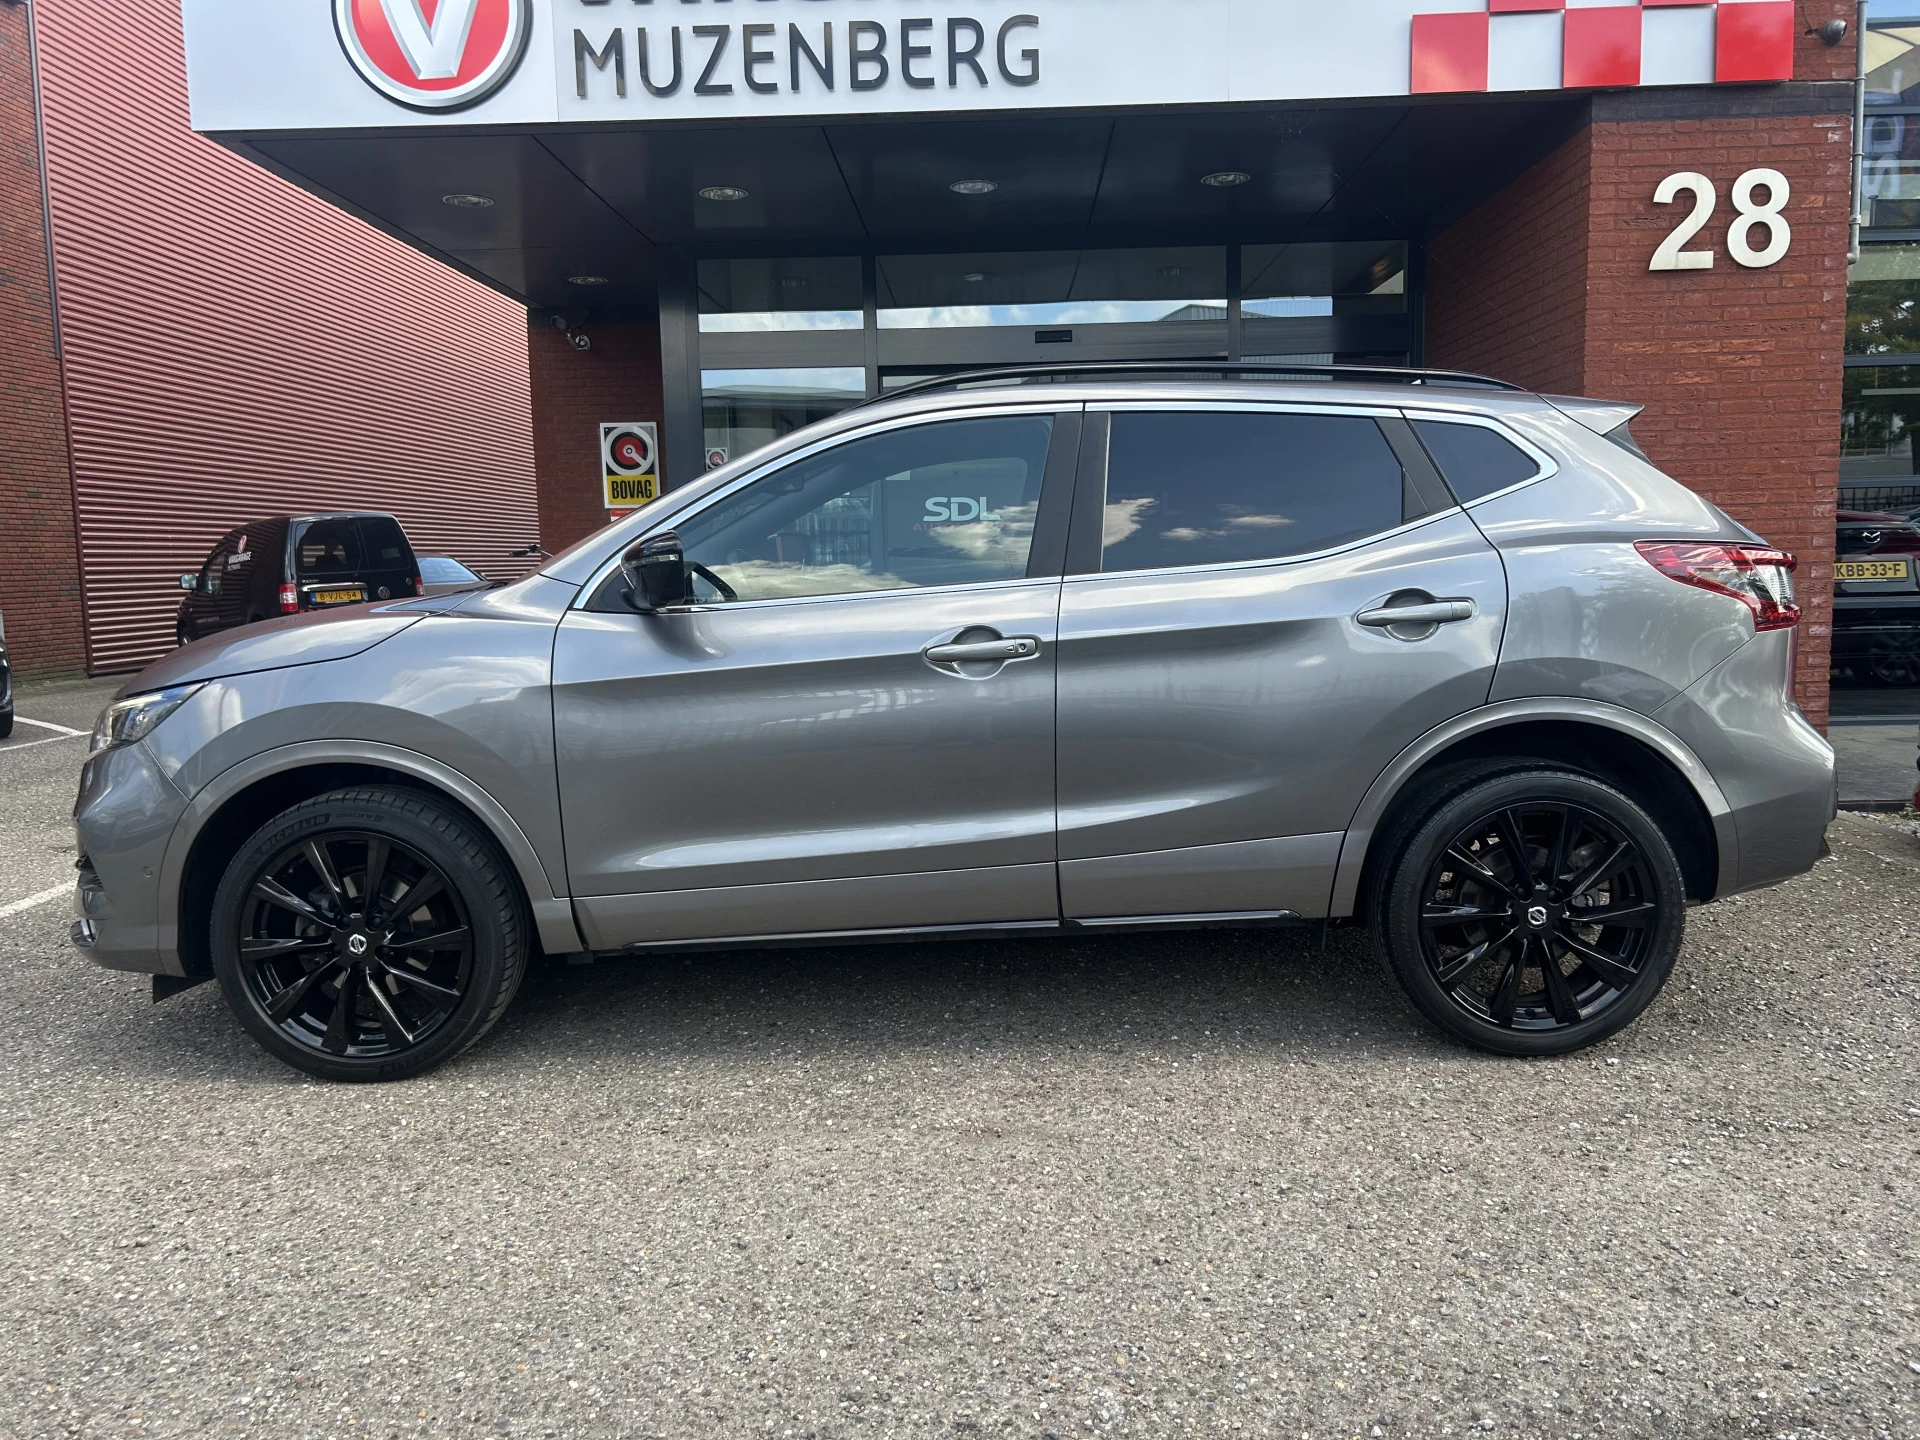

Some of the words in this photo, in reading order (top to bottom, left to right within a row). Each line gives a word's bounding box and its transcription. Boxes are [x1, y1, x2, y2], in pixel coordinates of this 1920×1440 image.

[573, 14, 1040, 98] MUZENBERG
[1648, 167, 1791, 271] 28
[611, 480, 653, 500] BOVAG
[922, 496, 1001, 522] SDL
[1835, 563, 1901, 577] KBB-33-F
[319, 590, 357, 602] 8-VJL-54
